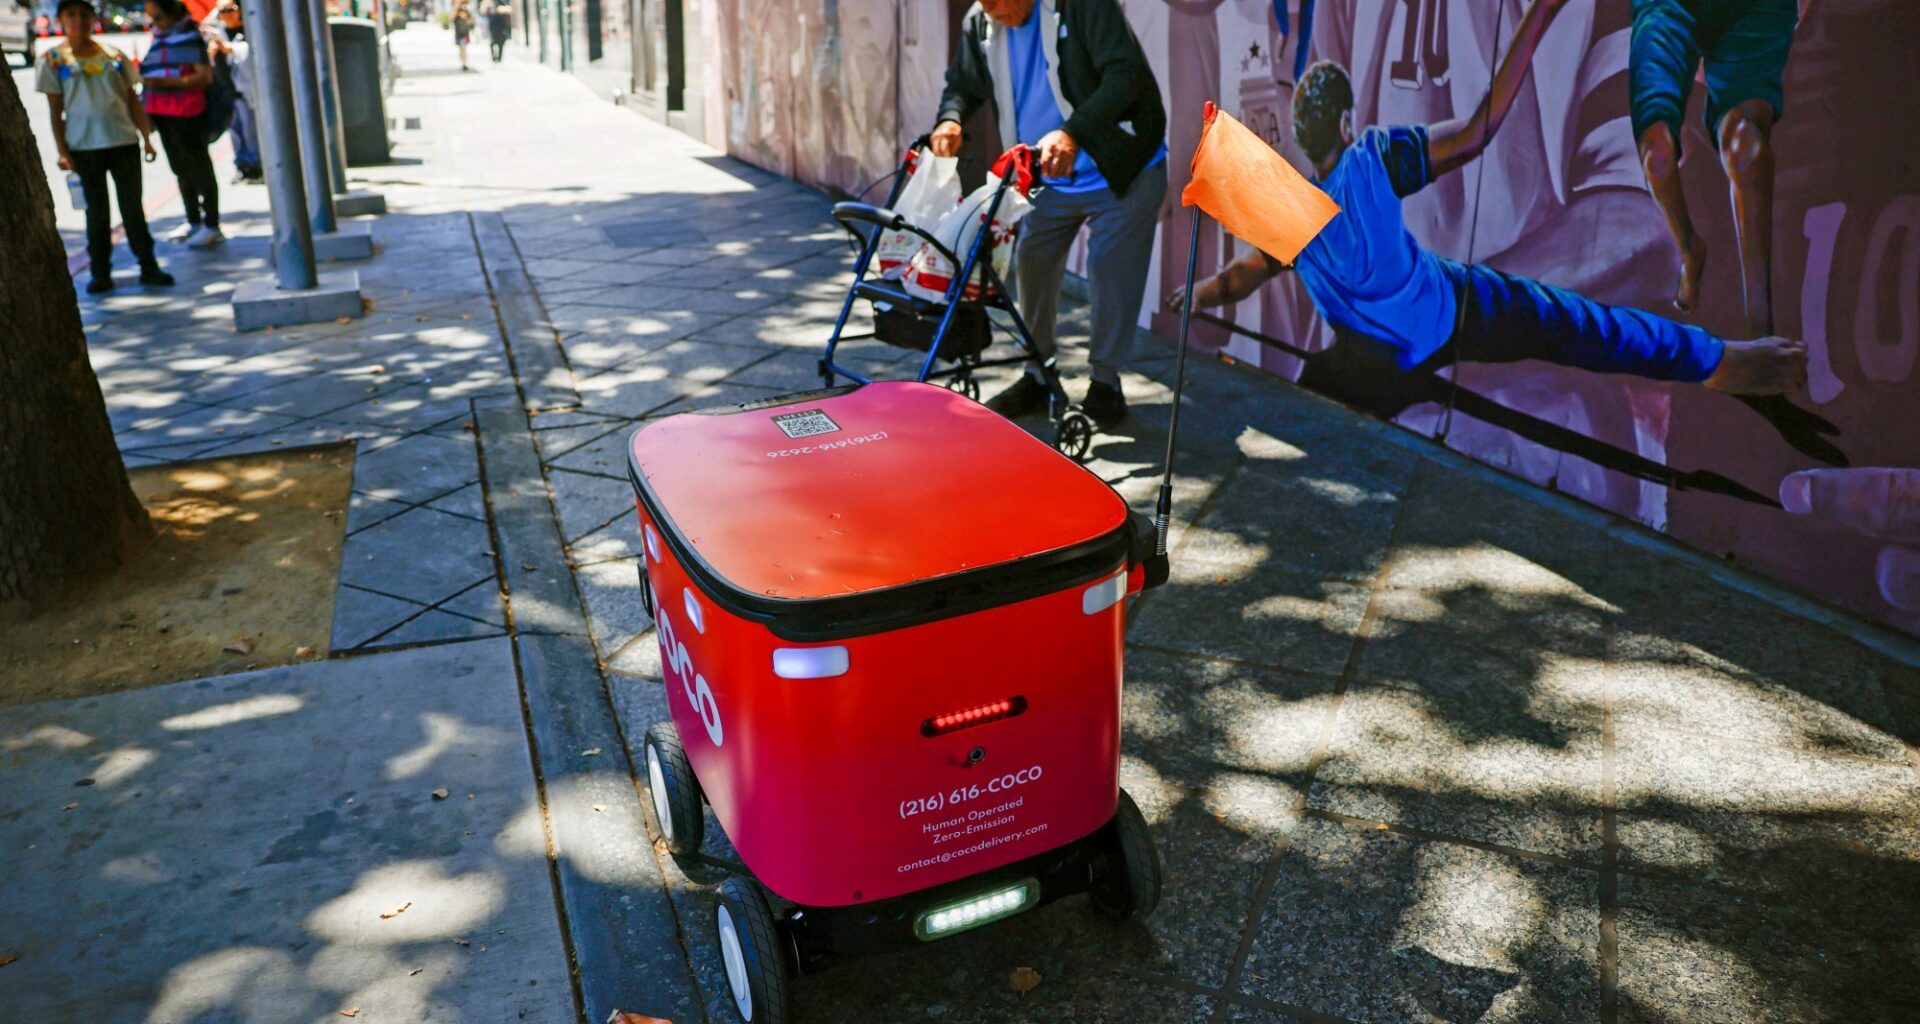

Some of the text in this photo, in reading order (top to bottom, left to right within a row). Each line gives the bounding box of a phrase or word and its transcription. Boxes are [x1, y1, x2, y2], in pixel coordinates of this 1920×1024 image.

[766, 431, 888, 459] (216)616-2626
[899, 765, 1043, 819] (216) 616-COCO
[922, 796, 1024, 833] Human Operated
[932, 814, 1015, 844] Zero-Emission
[896, 821, 1048, 873] contact@cocodelivery.com
